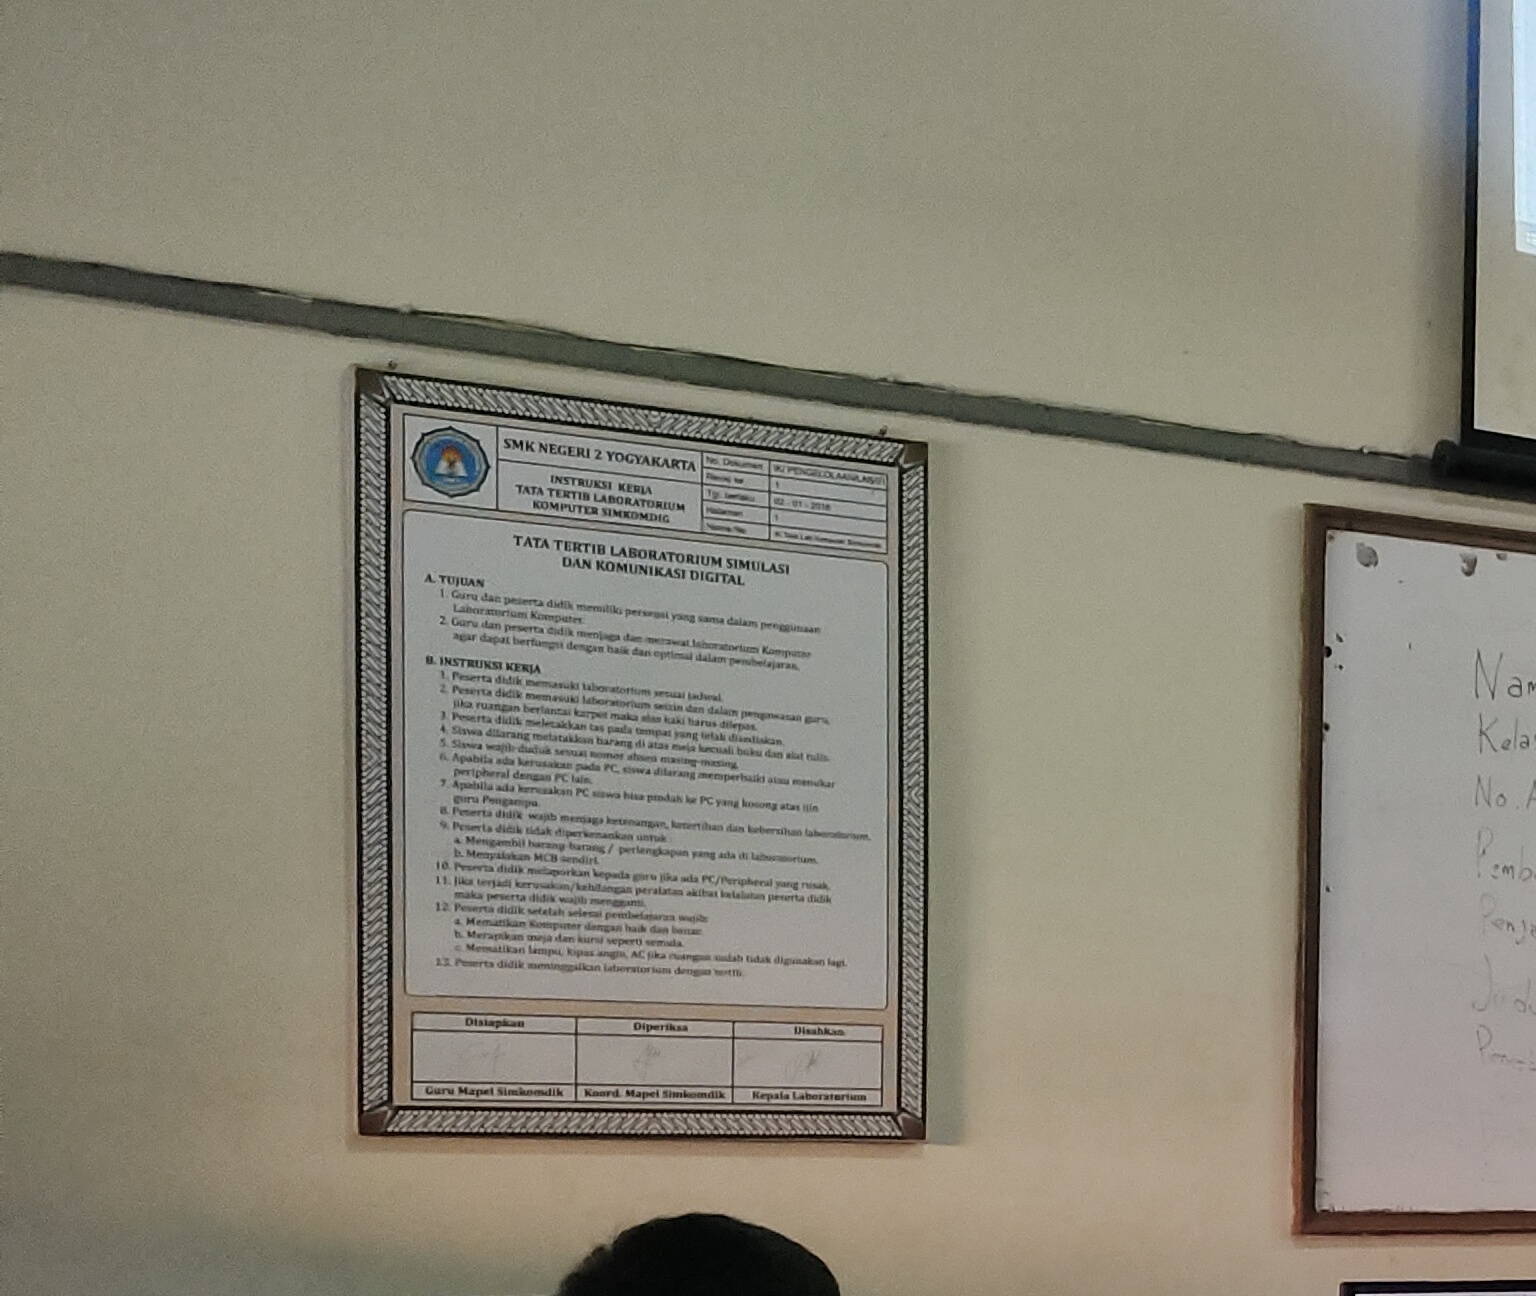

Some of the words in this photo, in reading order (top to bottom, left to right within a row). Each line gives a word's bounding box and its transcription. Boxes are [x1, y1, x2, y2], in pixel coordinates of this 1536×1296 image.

[503, 436, 535, 452] SMK
[537, 441, 591, 458] NEGERI
[593, 448, 603, 460] 2
[606, 449, 696, 471] YOGYAKARTA
[515, 483, 544, 496] TATA
[547, 486, 591, 501] TERTIB
[592, 492, 686, 512] LABORATORIUM
[549, 473, 612, 490] INSTRUKSI
[617, 481, 652, 495] KERJA
[531, 498, 599, 515] KOMPUTER
[600, 506, 670, 523] SIMKOMDIG
[514, 534, 550, 549] TATA
[555, 538, 606, 555] TERTIB
[609, 544, 723, 567] LABORATORIUM
[725, 557, 790, 574] SIMULASI
[438, 574, 485, 589] TUJUAN
[561, 555, 592, 569] DAN
[595, 559, 686, 579] KOMUNIKASI
[689, 568, 742, 585] DIGITAL
[438, 655, 503, 670] INSTRUKSI
[504, 661, 541, 675] KERJA
